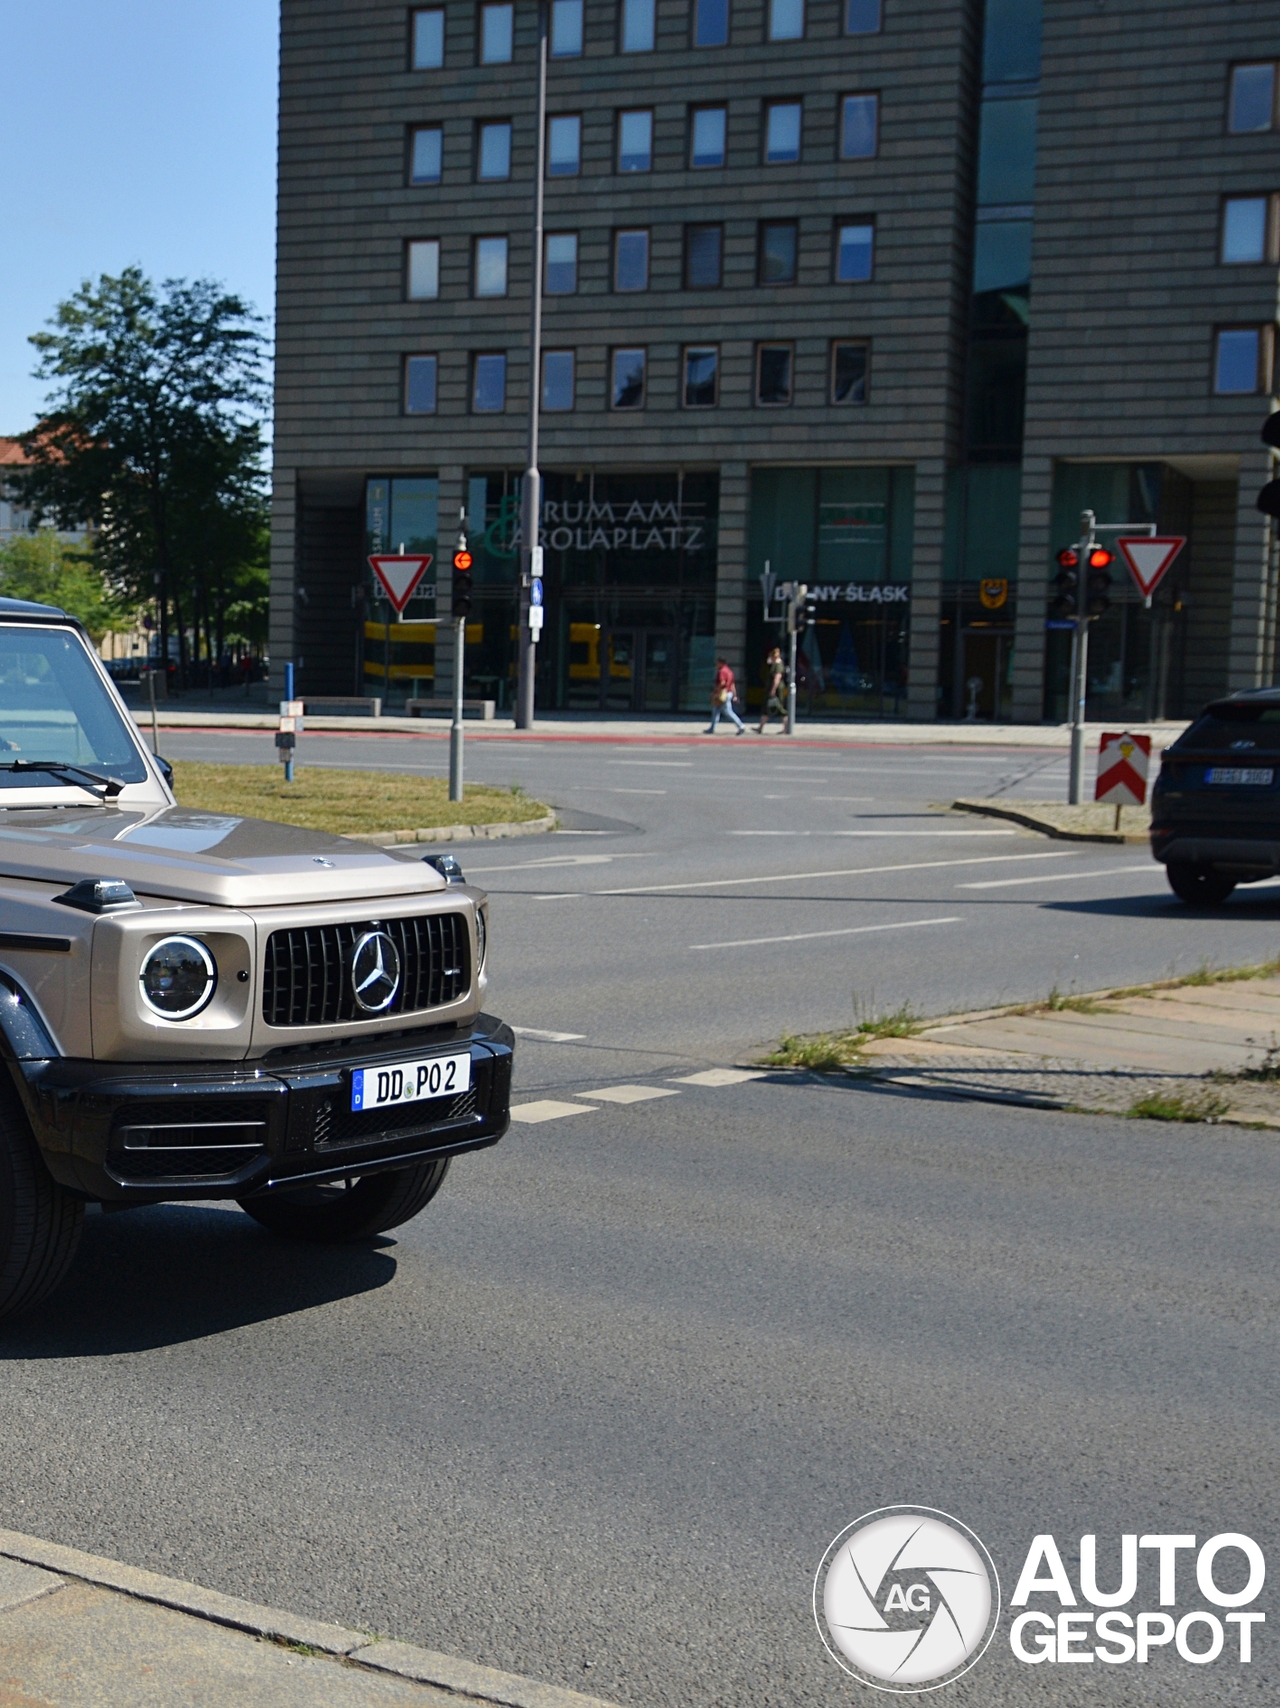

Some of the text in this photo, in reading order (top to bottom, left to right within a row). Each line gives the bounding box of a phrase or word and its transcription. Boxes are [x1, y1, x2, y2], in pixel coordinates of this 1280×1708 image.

[500, 496, 680, 530] FRUM AM
[774, 581, 908, 604] DNY ŚLĄSK
[354, 1094, 361, 1104] D
[376, 1069, 404, 1104] DD
